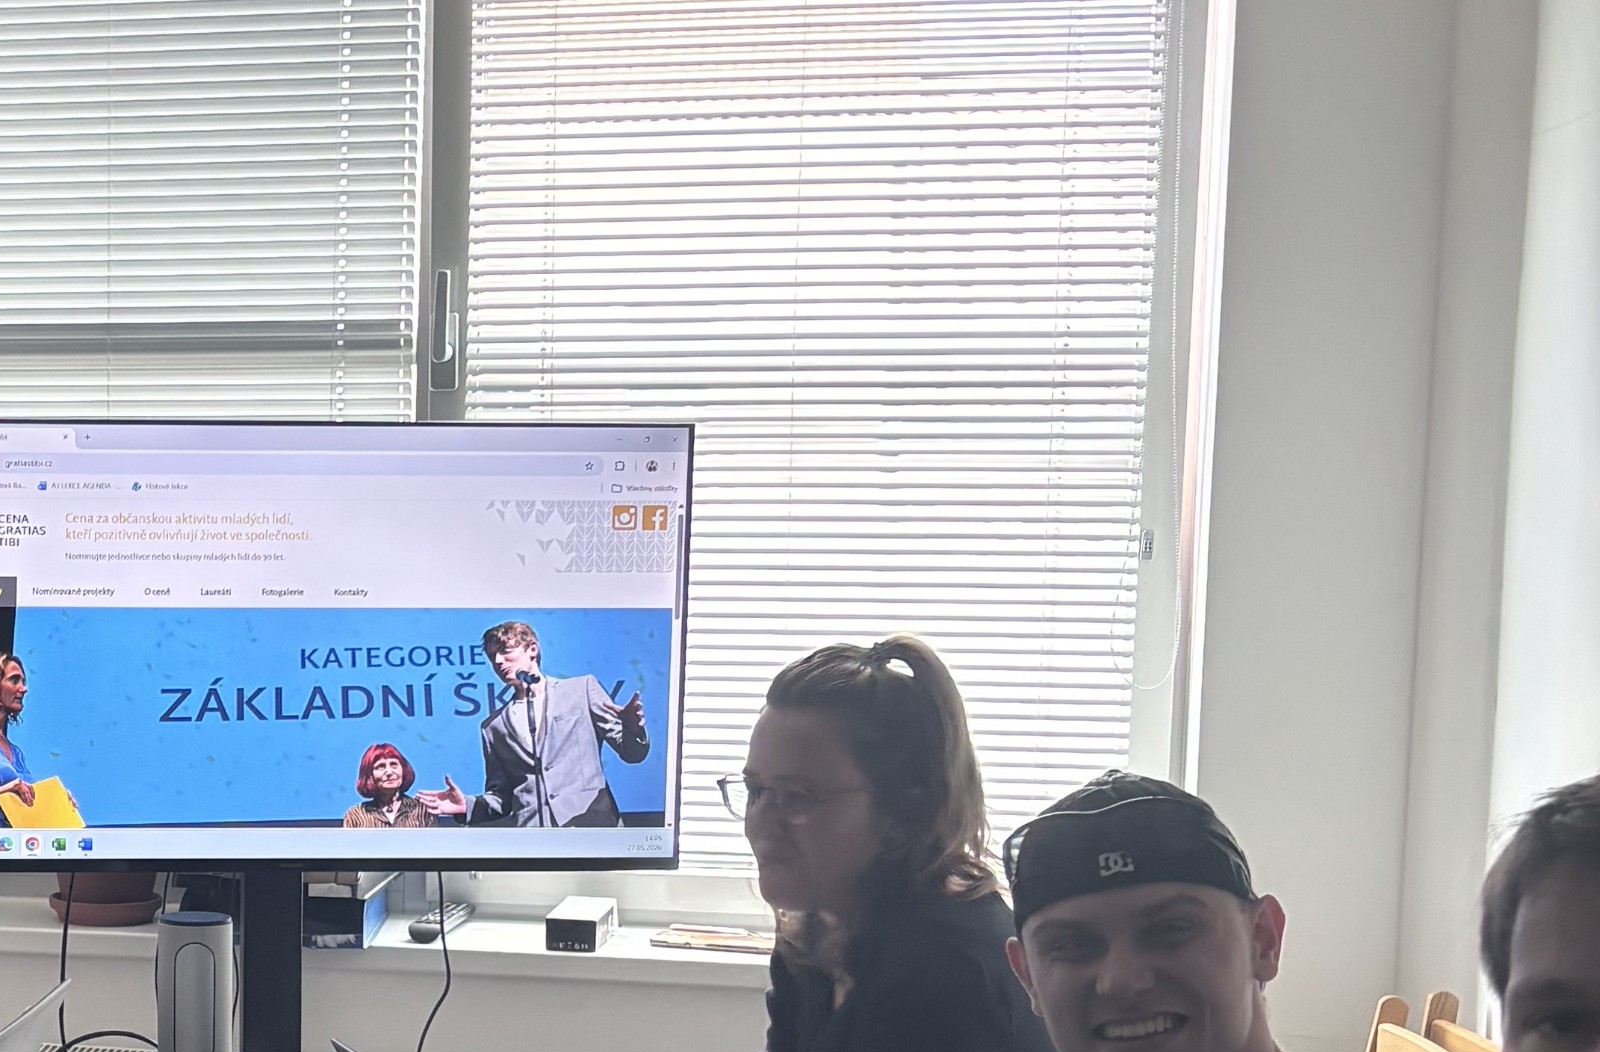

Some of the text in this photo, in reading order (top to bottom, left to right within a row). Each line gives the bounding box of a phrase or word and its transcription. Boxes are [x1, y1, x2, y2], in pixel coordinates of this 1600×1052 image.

[65, 512, 294, 527] Cena za občanskou aktivitu mladých lidí,
[65, 528, 92, 540] kteří
[94, 528, 147, 543] pozitivně
[149, 528, 199, 543] ovlivňují
[200, 529, 227, 541] život
[230, 531, 243, 541] ve
[65, 552, 107, 562] Nominujte
[108, 552, 150, 562] jednotlivce
[151, 553, 171, 561] nebo
[172, 552, 202, 562] skupiny
[203, 552, 236, 562] mladých
[251, 553, 261, 561] do
[32, 586, 115, 598] Nominované projekty
[200, 587, 232, 596] Laureáti
[262, 587, 305, 598] Fotogalerie
[334, 588, 369, 598] Kontakty
[299, 645, 485, 670] KATEGORIE
[158, 672, 434, 723] ZÁKLADNÍ
